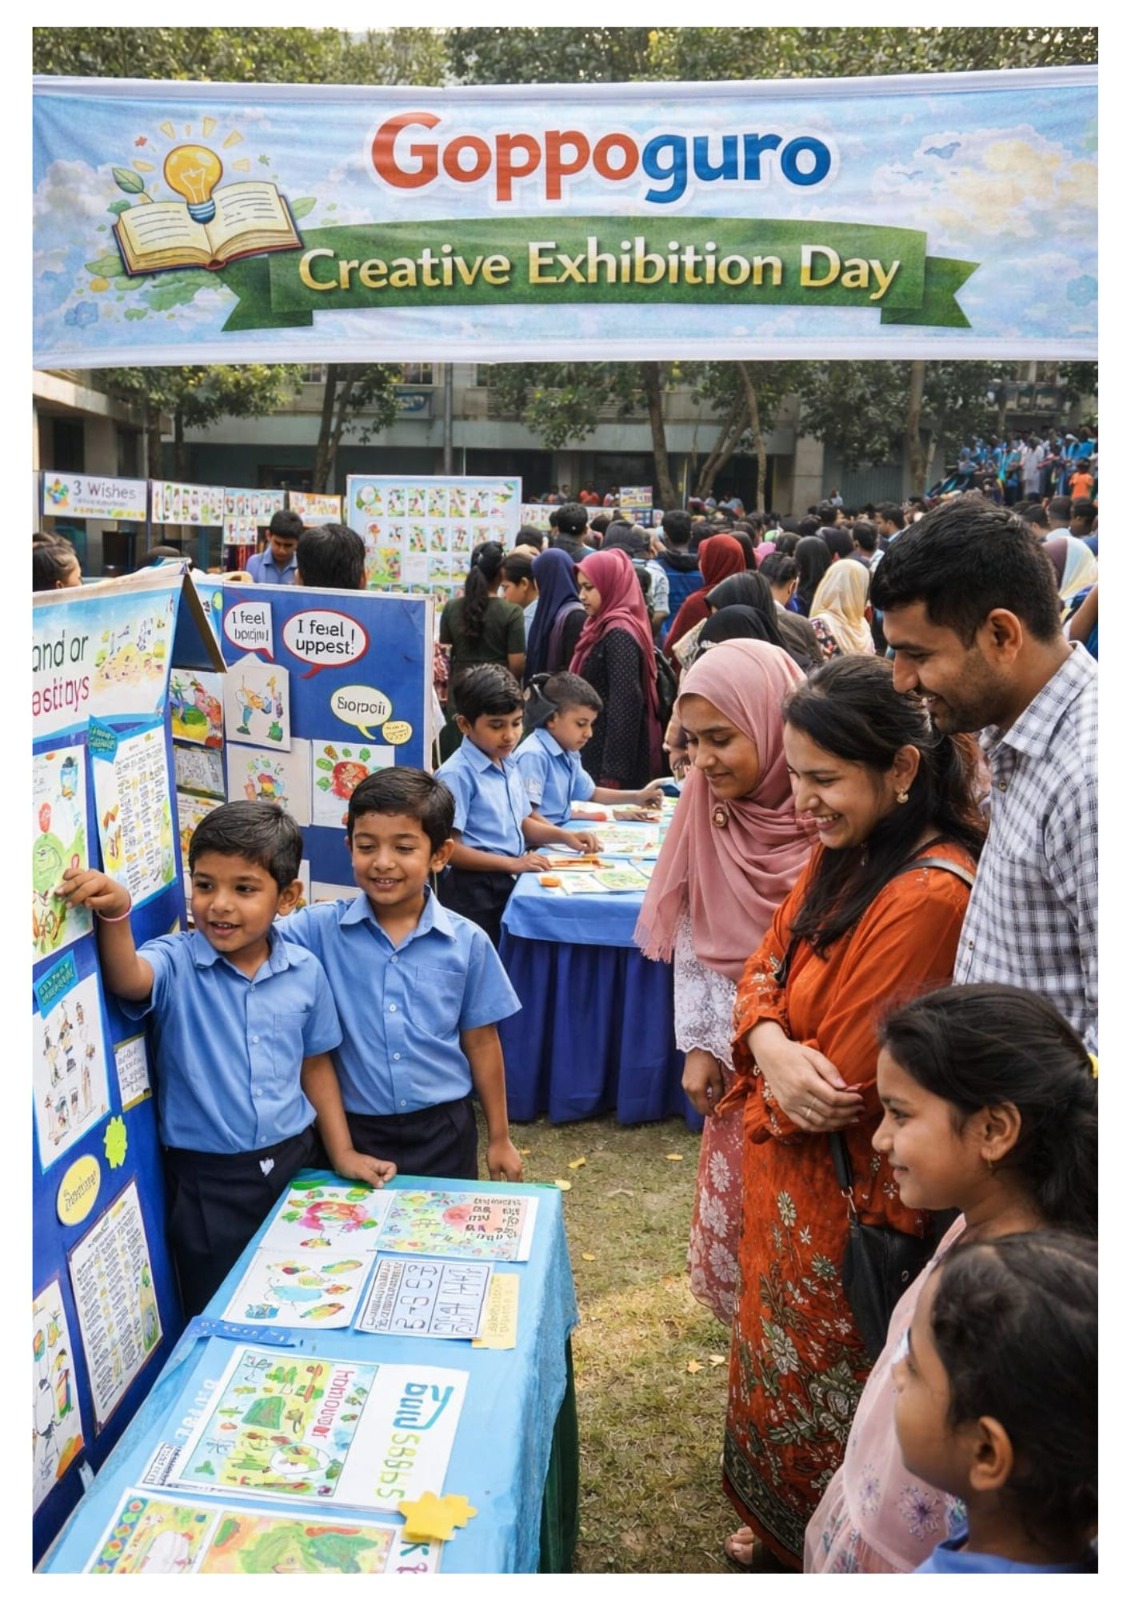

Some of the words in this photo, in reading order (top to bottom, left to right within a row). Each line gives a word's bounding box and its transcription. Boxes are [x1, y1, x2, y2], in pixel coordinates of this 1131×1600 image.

[371, 111, 832, 204] Goppoguro
[299, 244, 511, 291] Creative
[528, 236, 783, 287] Exhibition
[800, 244, 901, 300] Day
[73, 480, 82, 496] 3
[87, 481, 137, 499] Wishes
[232, 611, 237, 624] I
[240, 611, 265, 625] feel
[297, 619, 304, 634] I
[70, 635, 89, 662] or
